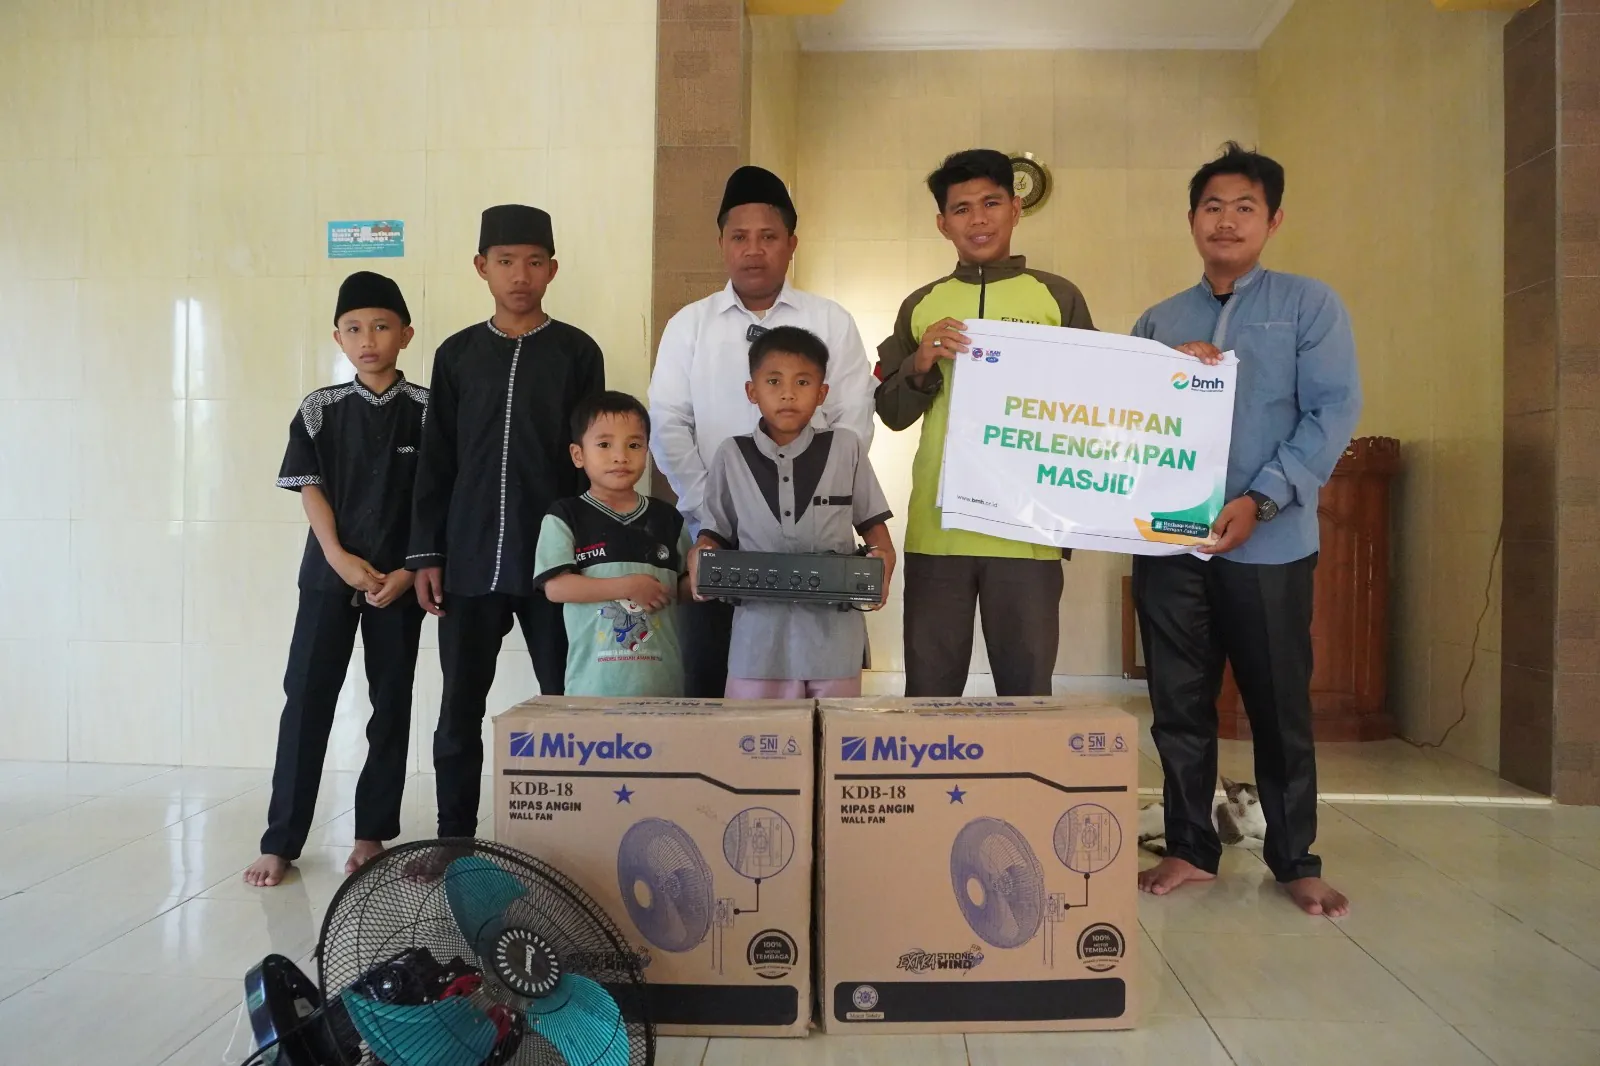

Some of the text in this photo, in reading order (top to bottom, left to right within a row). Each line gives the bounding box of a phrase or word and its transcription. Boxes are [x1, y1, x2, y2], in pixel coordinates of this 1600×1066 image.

[1191, 374, 1224, 389] bmh
[1004, 396, 1182, 437] PENYALURAN
[983, 425, 1197, 471] PERLENGKAPAN
[1036, 464, 1135, 496] MASJID
[576, 547, 606, 562] KETUA
[539, 732, 653, 765] Miyako
[760, 737, 778, 750] SNI
[1088, 735, 1106, 748] SNI
[872, 735, 984, 768] Miyako
[509, 781, 573, 797] KDB-18
[841, 785, 906, 800] KDB-18
[509, 800, 582, 811] KIPAS ANGIN
[841, 804, 915, 814] KIPAS ANGIN
[509, 812, 533, 820] WALL
[841, 816, 886, 824] WALL FAN
[896, 952, 936, 971] EXTRA
[937, 952, 974, 960] STRONG
[937, 960, 972, 969] WIND
